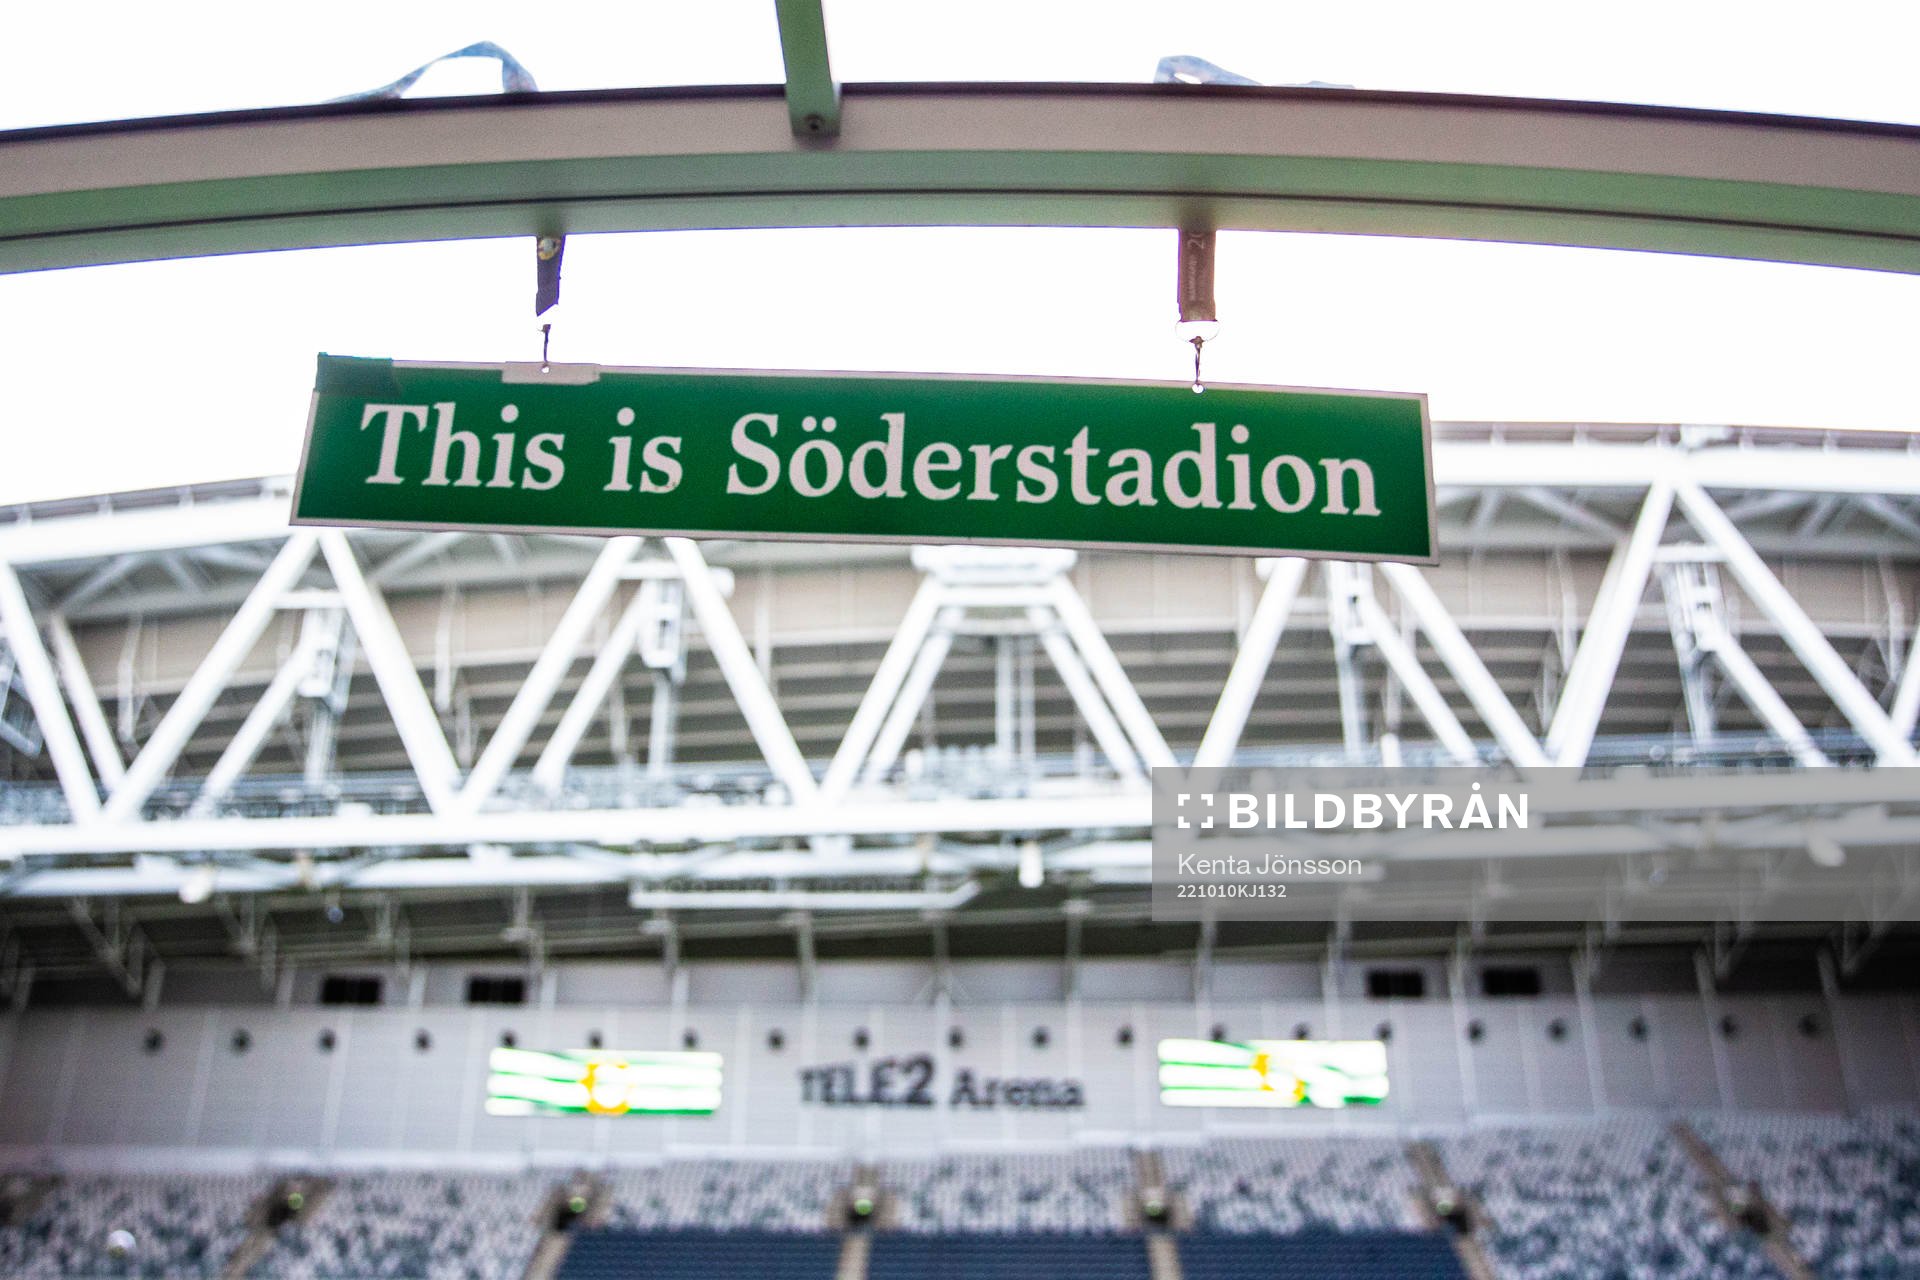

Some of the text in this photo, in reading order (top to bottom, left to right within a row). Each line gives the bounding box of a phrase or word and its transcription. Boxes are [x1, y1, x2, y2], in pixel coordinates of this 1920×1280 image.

[361, 401, 1382, 517] This is Söderstadion
